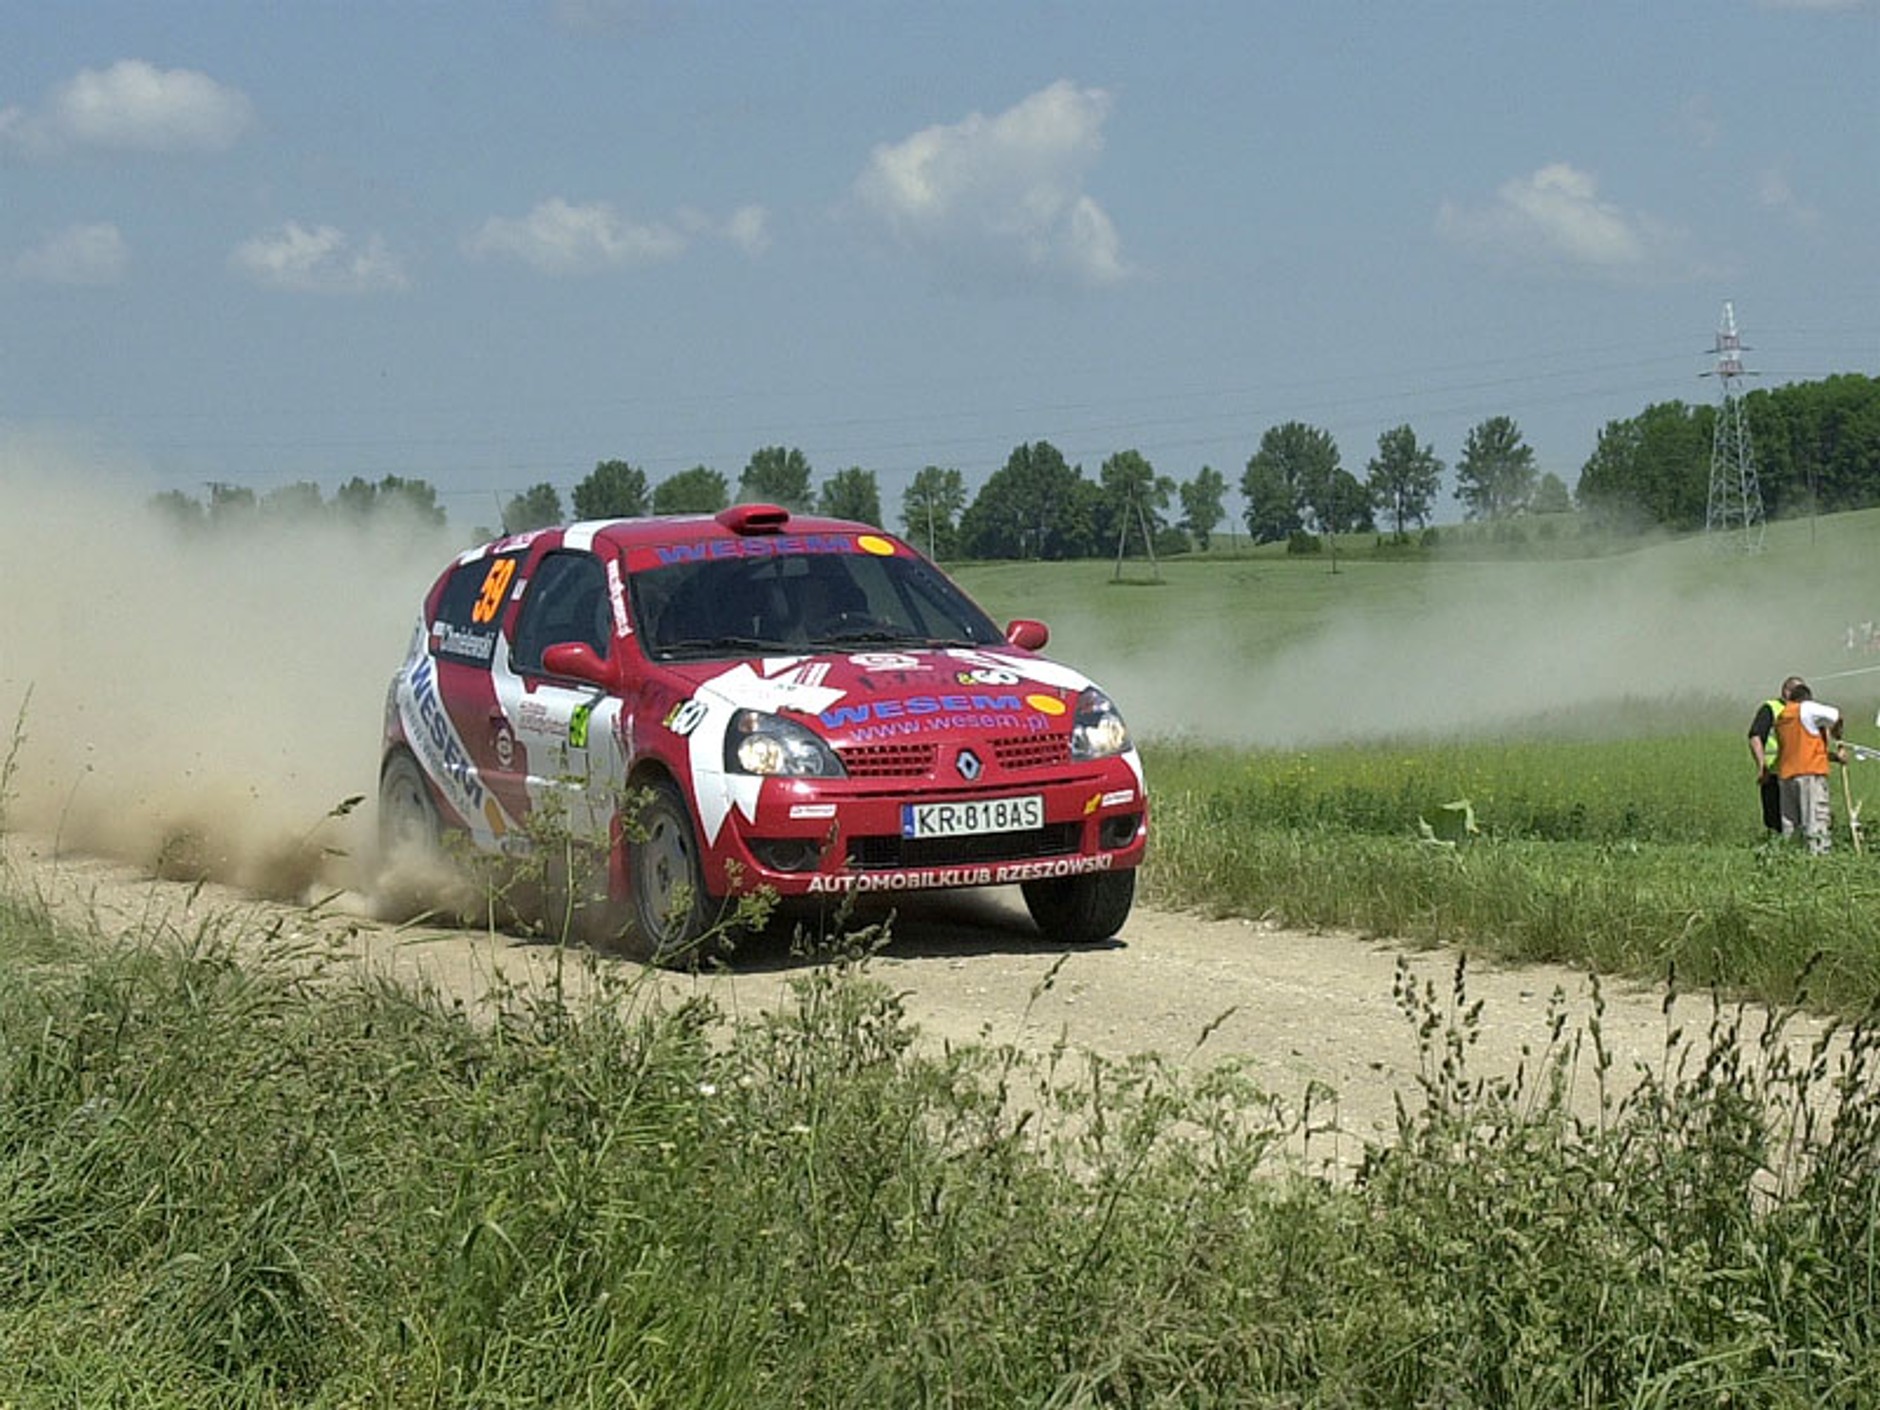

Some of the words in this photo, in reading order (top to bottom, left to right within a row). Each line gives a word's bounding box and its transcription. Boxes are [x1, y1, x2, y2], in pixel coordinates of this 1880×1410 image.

[658, 537, 852, 564] WESEM
[820, 695, 1023, 728] WESEM
[851, 713, 1049, 741] www.wesem.pl
[411, 656, 481, 809] WESEM
[917, 806, 955, 833] KR
[965, 800, 1039, 829] 818AS
[807, 872, 990, 893] AUTOMOBILKLUB
[995, 854, 1113, 882] RZESZOWSKI
